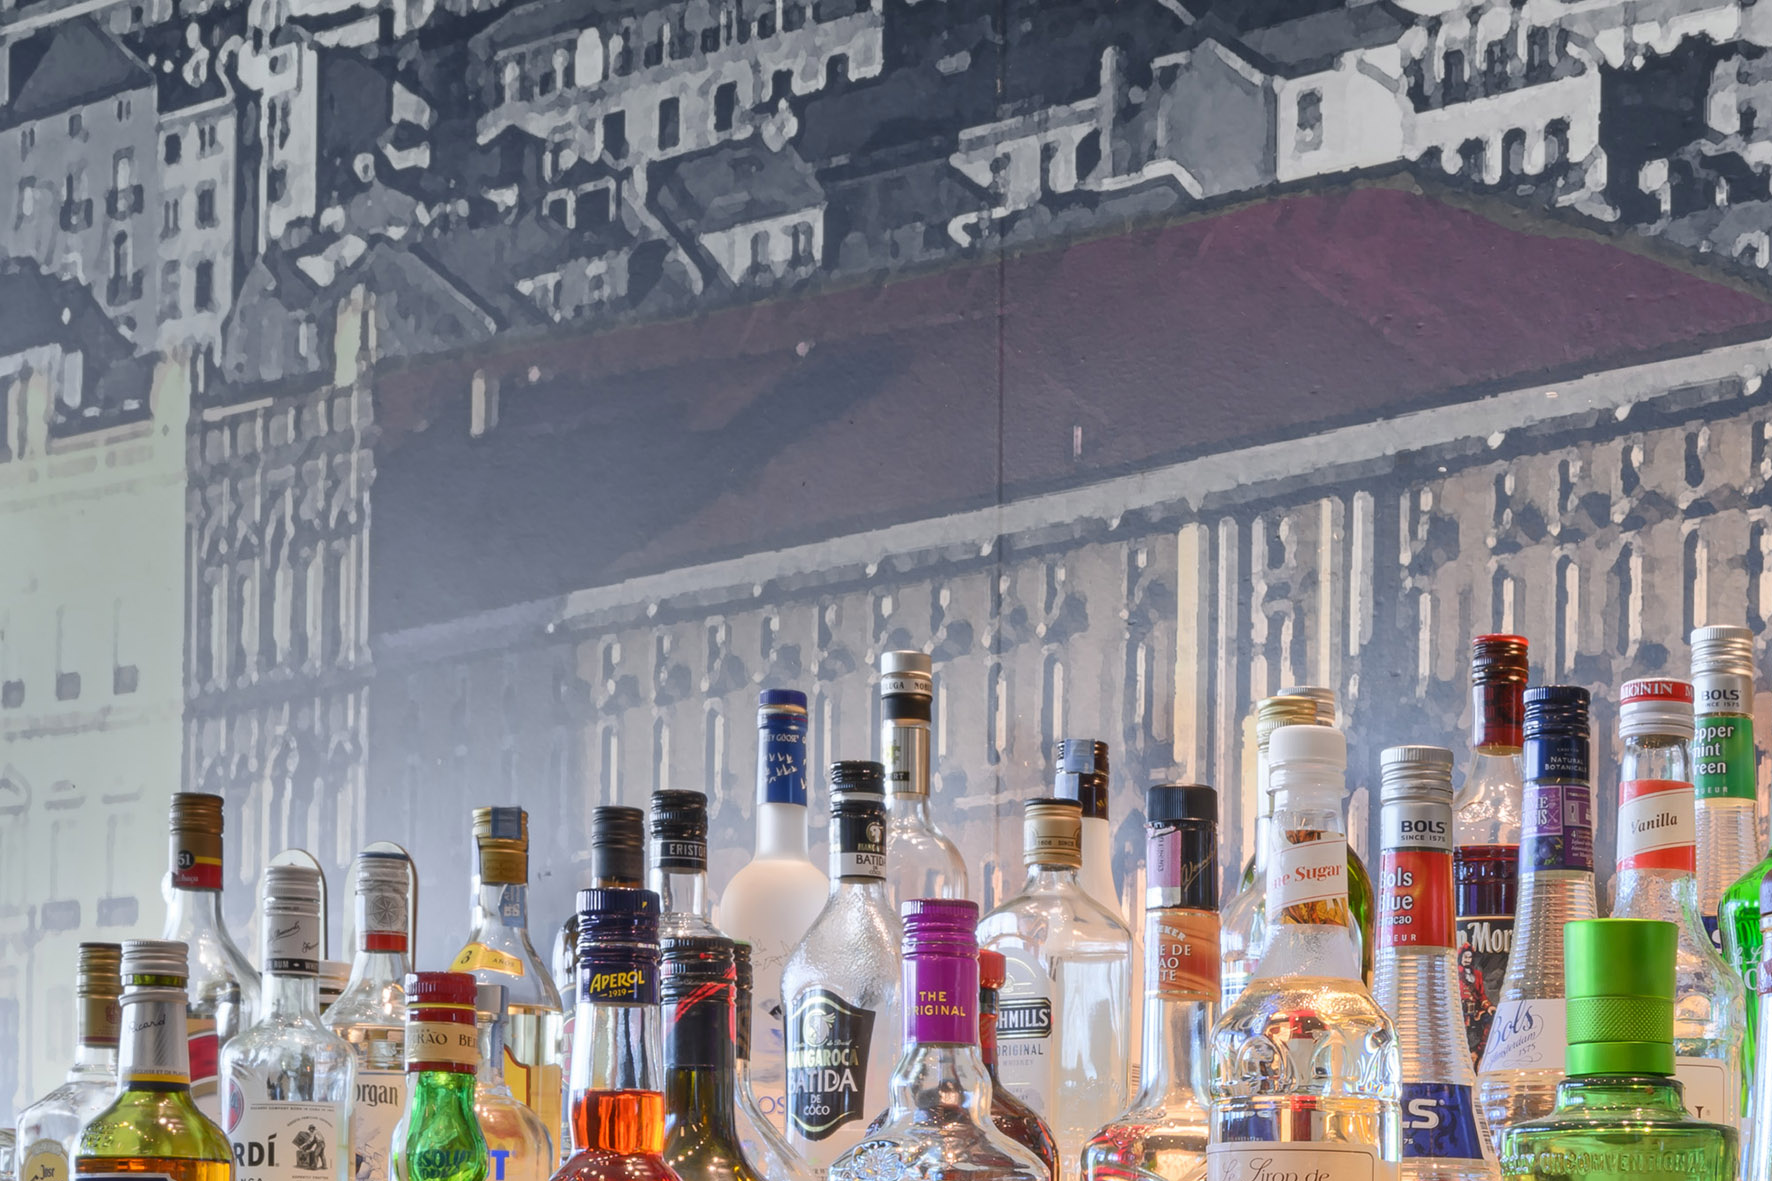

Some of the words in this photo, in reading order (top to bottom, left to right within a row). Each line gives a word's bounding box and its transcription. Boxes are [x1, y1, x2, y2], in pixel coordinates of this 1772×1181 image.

[1401, 820, 1446, 834] BOLS
[1631, 812, 1678, 835] Vanilla
[669, 843, 705, 856] ERISTO
[1294, 863, 1342, 882] Sugar
[590, 970, 645, 993] APEROL
[919, 991, 947, 1001] THE
[789, 1071, 858, 1094] BATIDA
[803, 1106, 830, 1116] COCO
